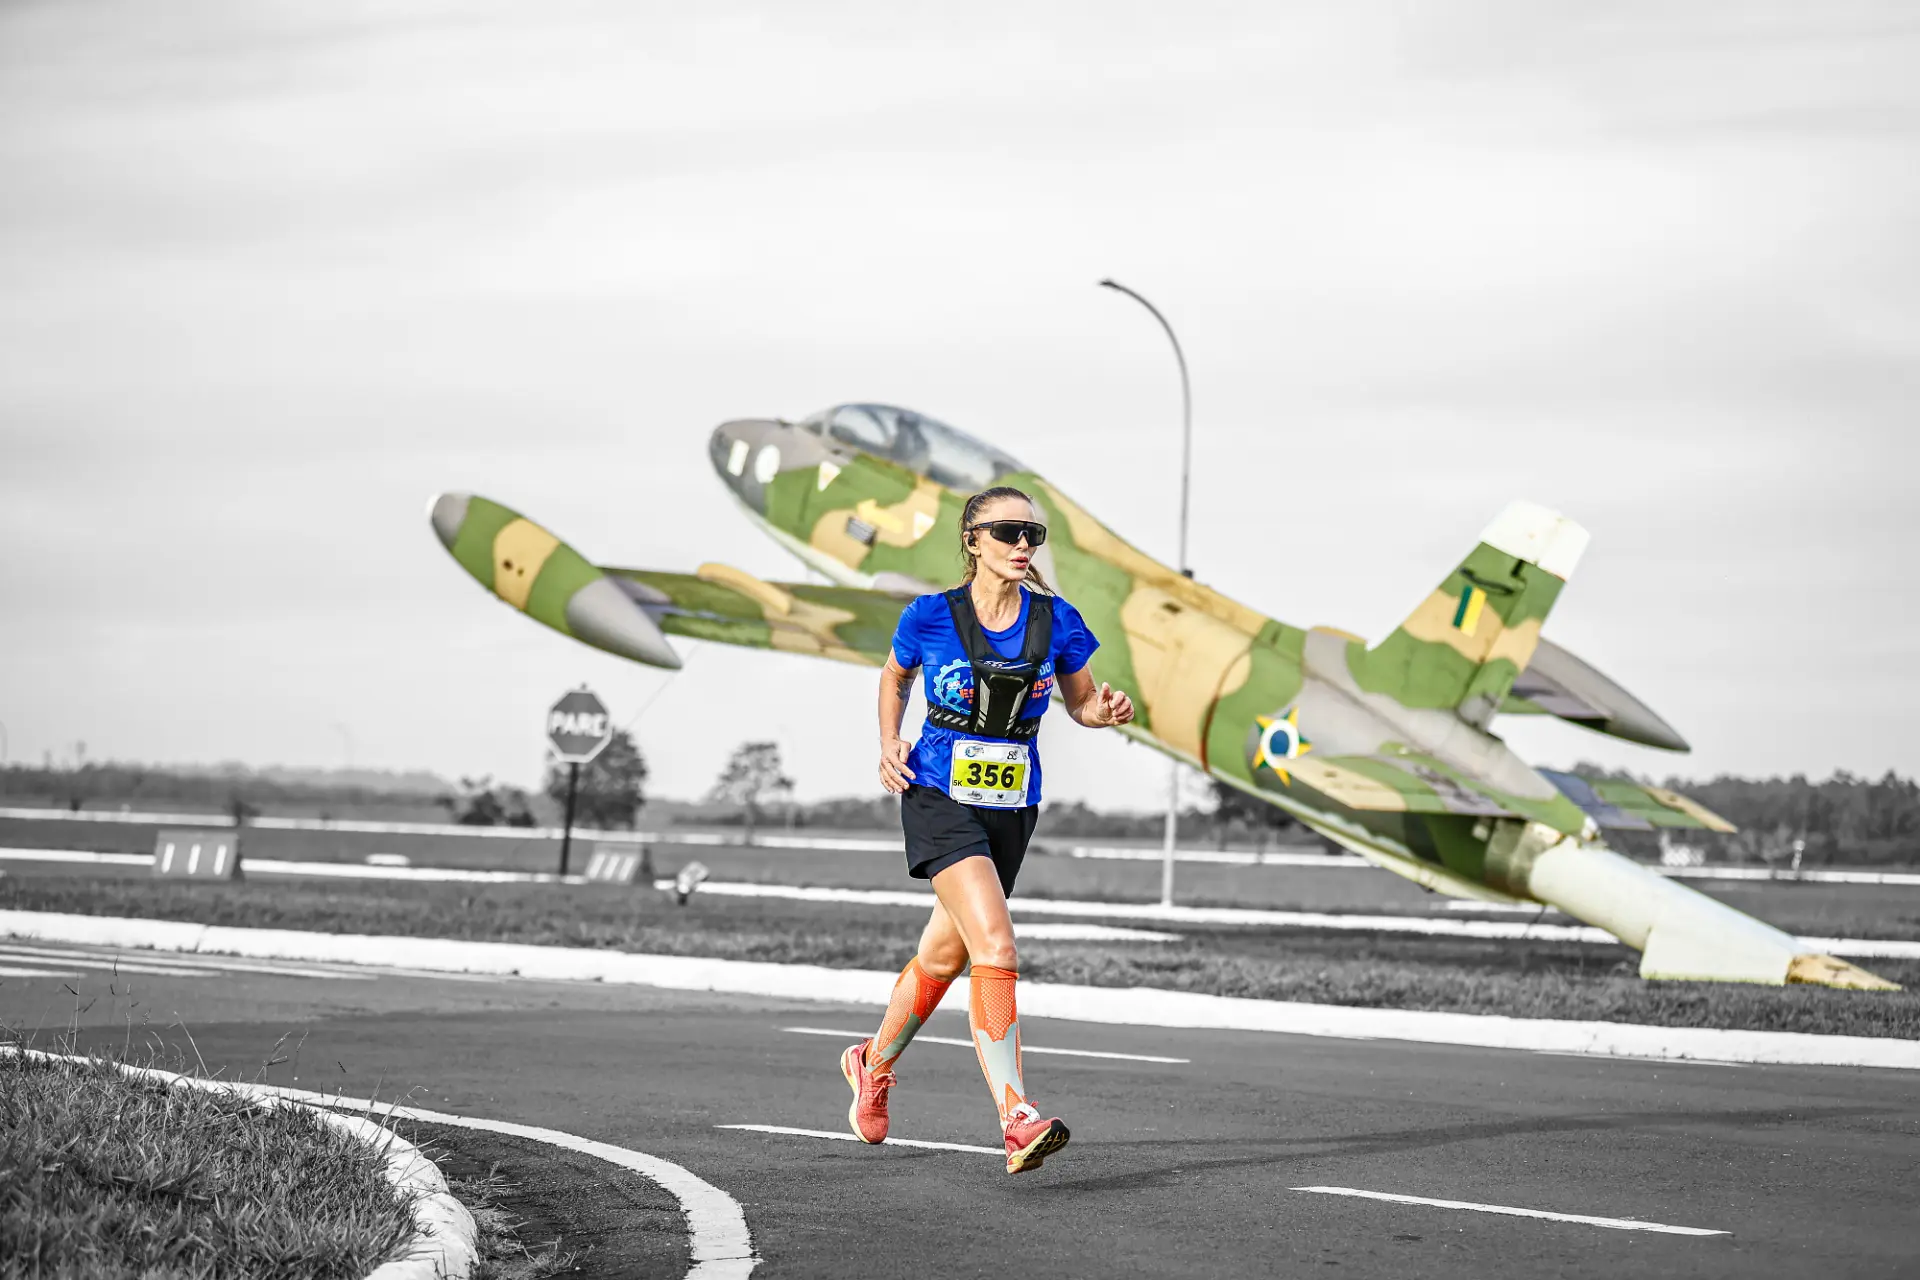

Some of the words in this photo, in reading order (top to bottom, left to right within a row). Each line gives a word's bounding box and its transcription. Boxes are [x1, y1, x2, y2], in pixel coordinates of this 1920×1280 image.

[551, 709, 605, 738] PARE
[953, 779, 963, 787] 5K
[966, 762, 1016, 789] 356
